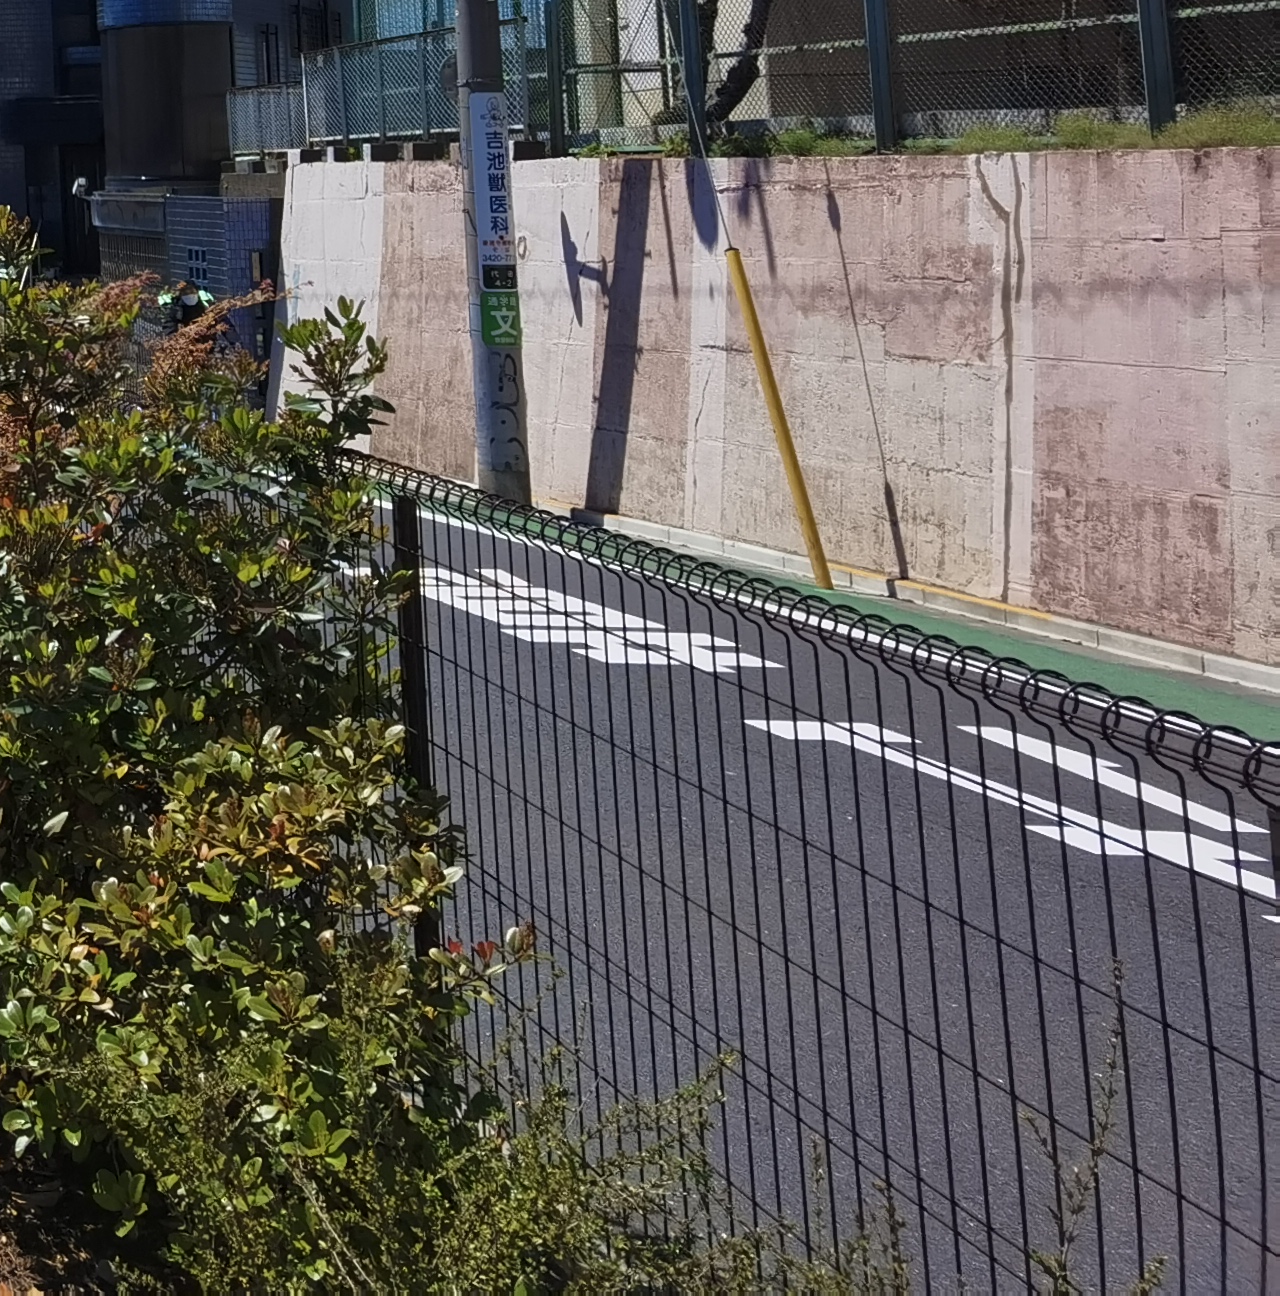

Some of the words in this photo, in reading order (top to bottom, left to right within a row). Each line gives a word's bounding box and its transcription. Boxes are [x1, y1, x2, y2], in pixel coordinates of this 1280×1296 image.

[485, 130, 509, 235] 吉池獣医科
[490, 307, 518, 336] 文
